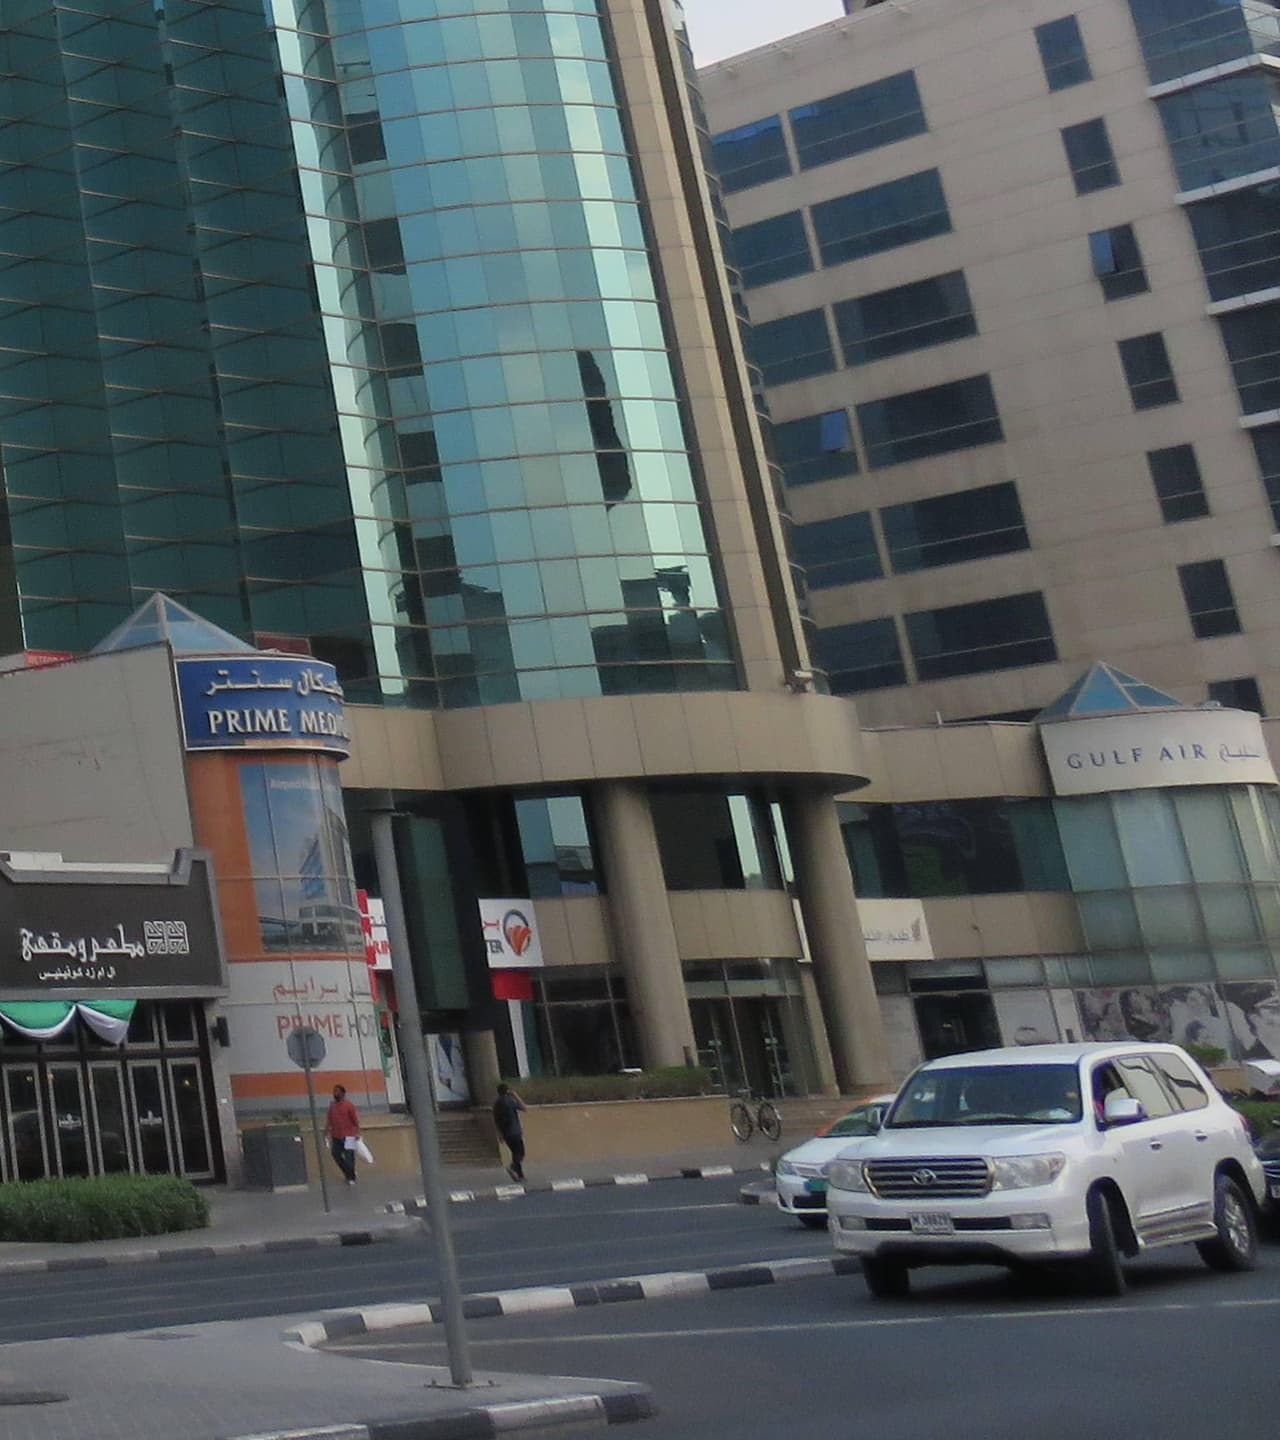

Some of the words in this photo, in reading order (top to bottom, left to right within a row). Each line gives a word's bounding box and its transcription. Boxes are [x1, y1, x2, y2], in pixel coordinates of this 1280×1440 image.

[208, 708, 292, 735] PRIME
[1067, 747, 1143, 769] GULF
[1159, 743, 1207, 761] AIR
